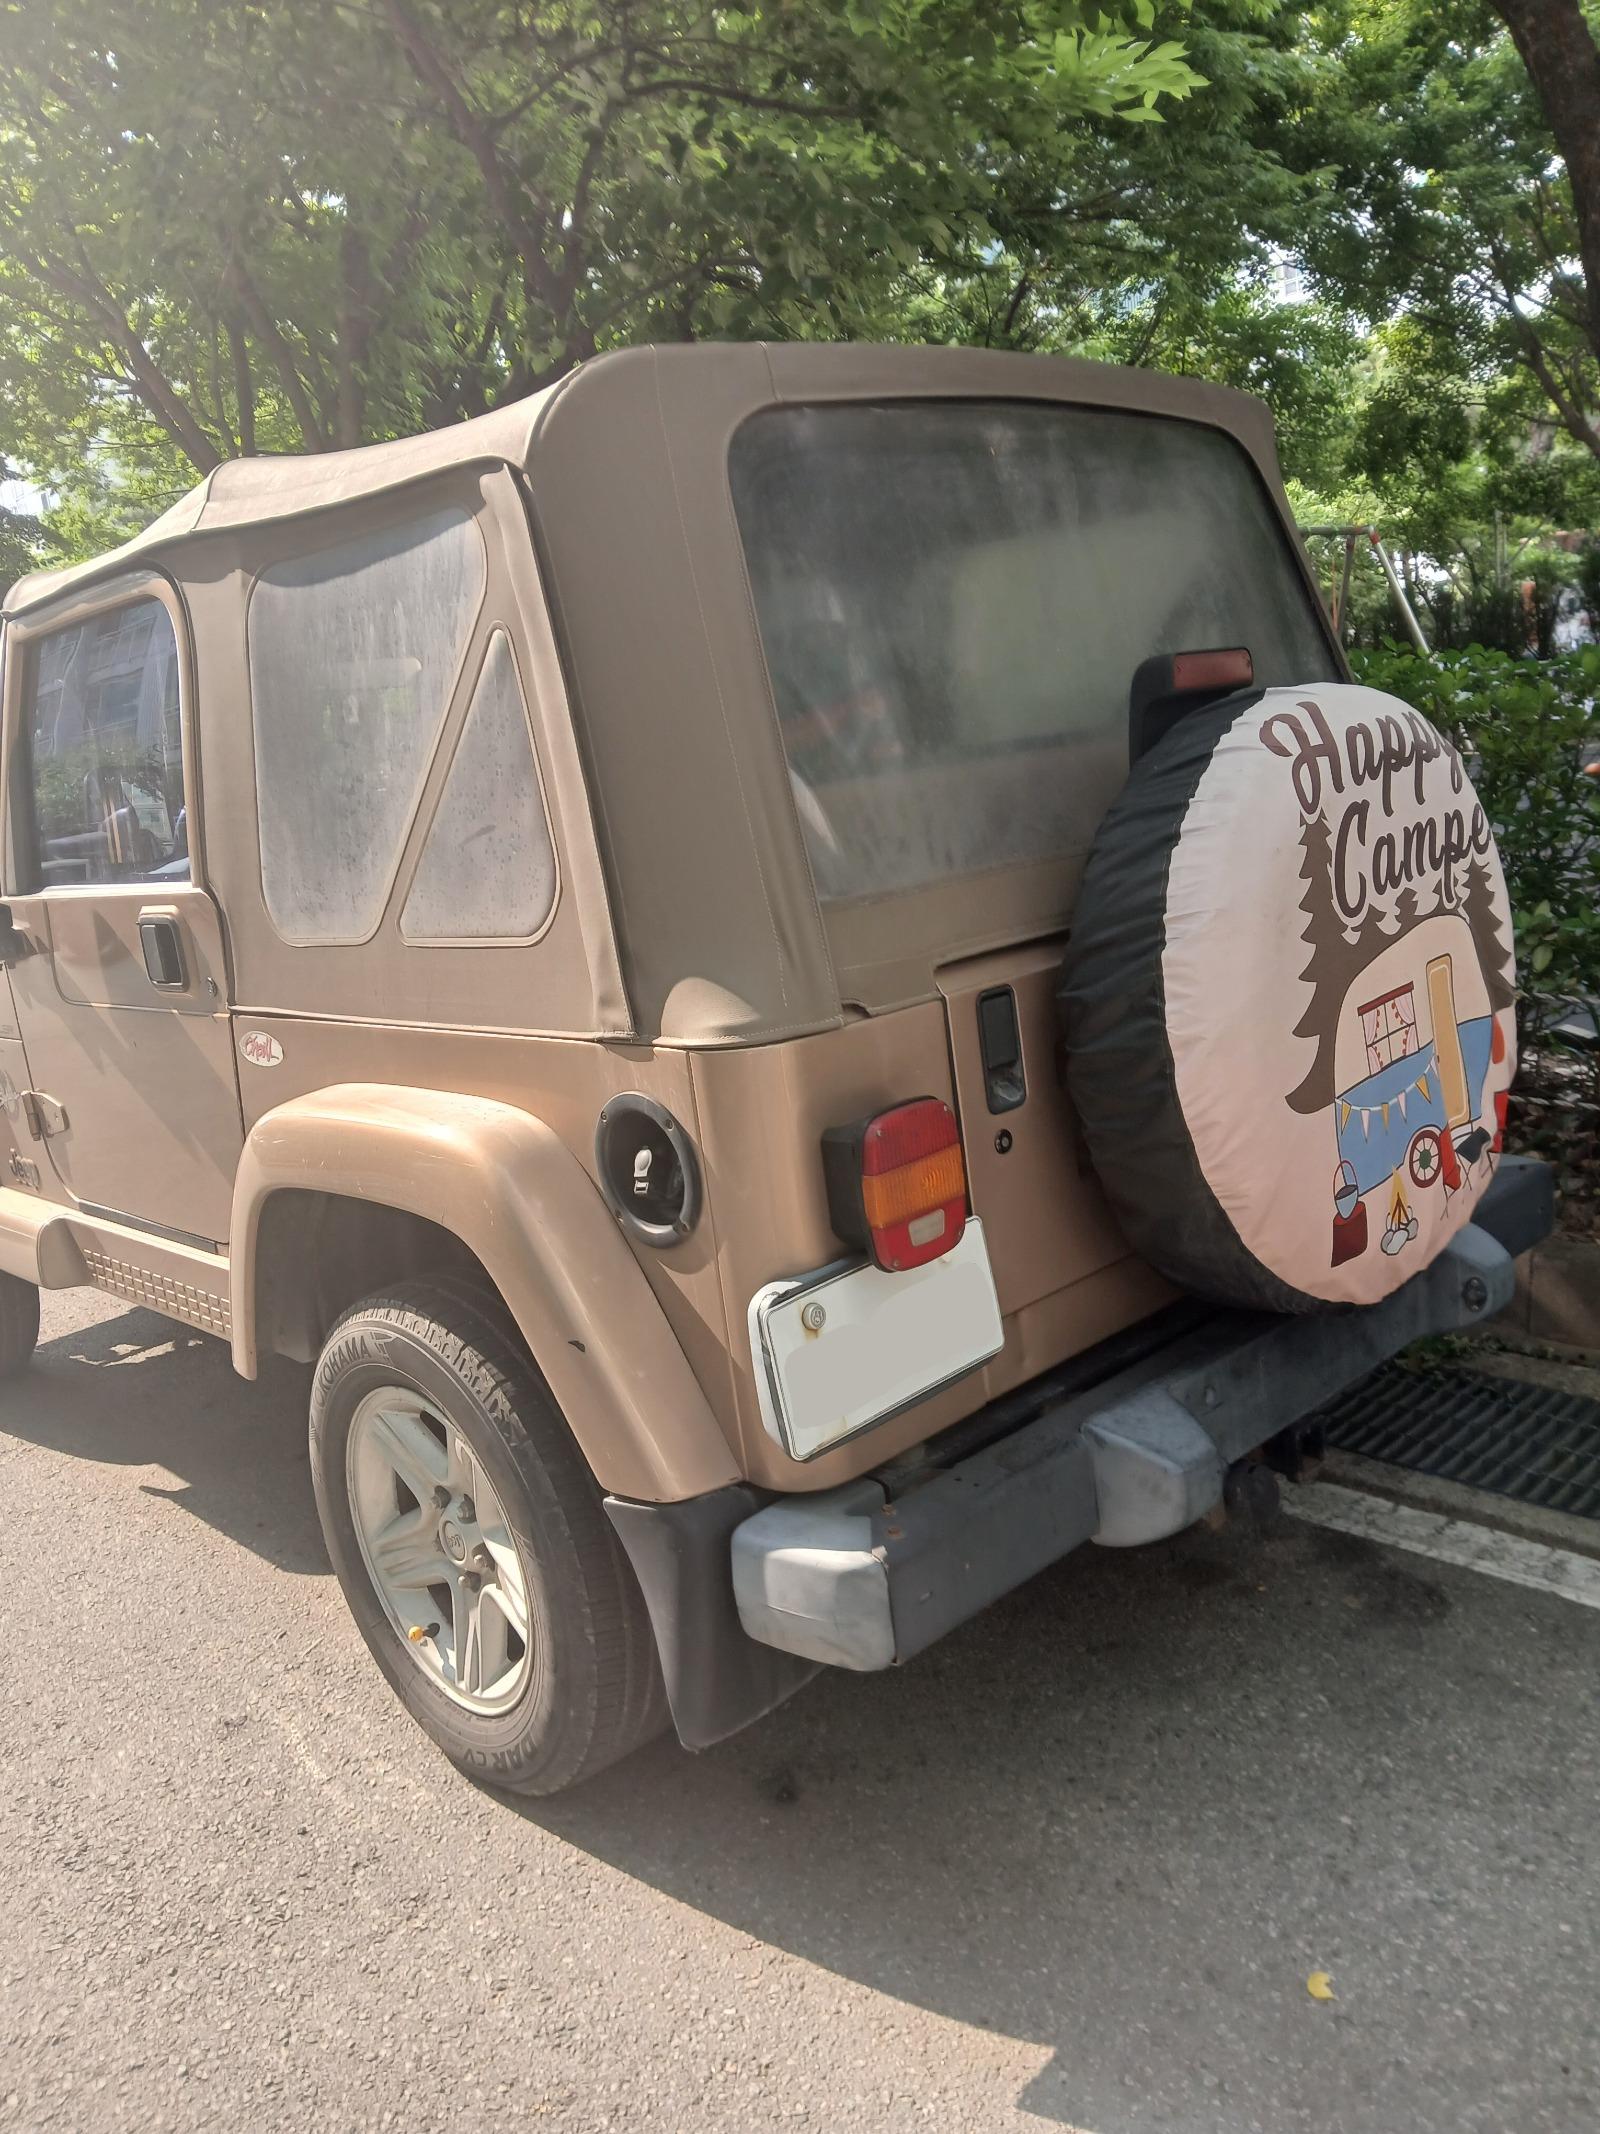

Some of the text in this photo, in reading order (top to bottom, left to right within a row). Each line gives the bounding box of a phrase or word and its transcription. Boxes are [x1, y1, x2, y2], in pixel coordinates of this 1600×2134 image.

[1259, 701, 1463, 817] Happy
[1333, 798, 1492, 919] Campe
[312, 1335, 373, 1412] OKOHAMA
